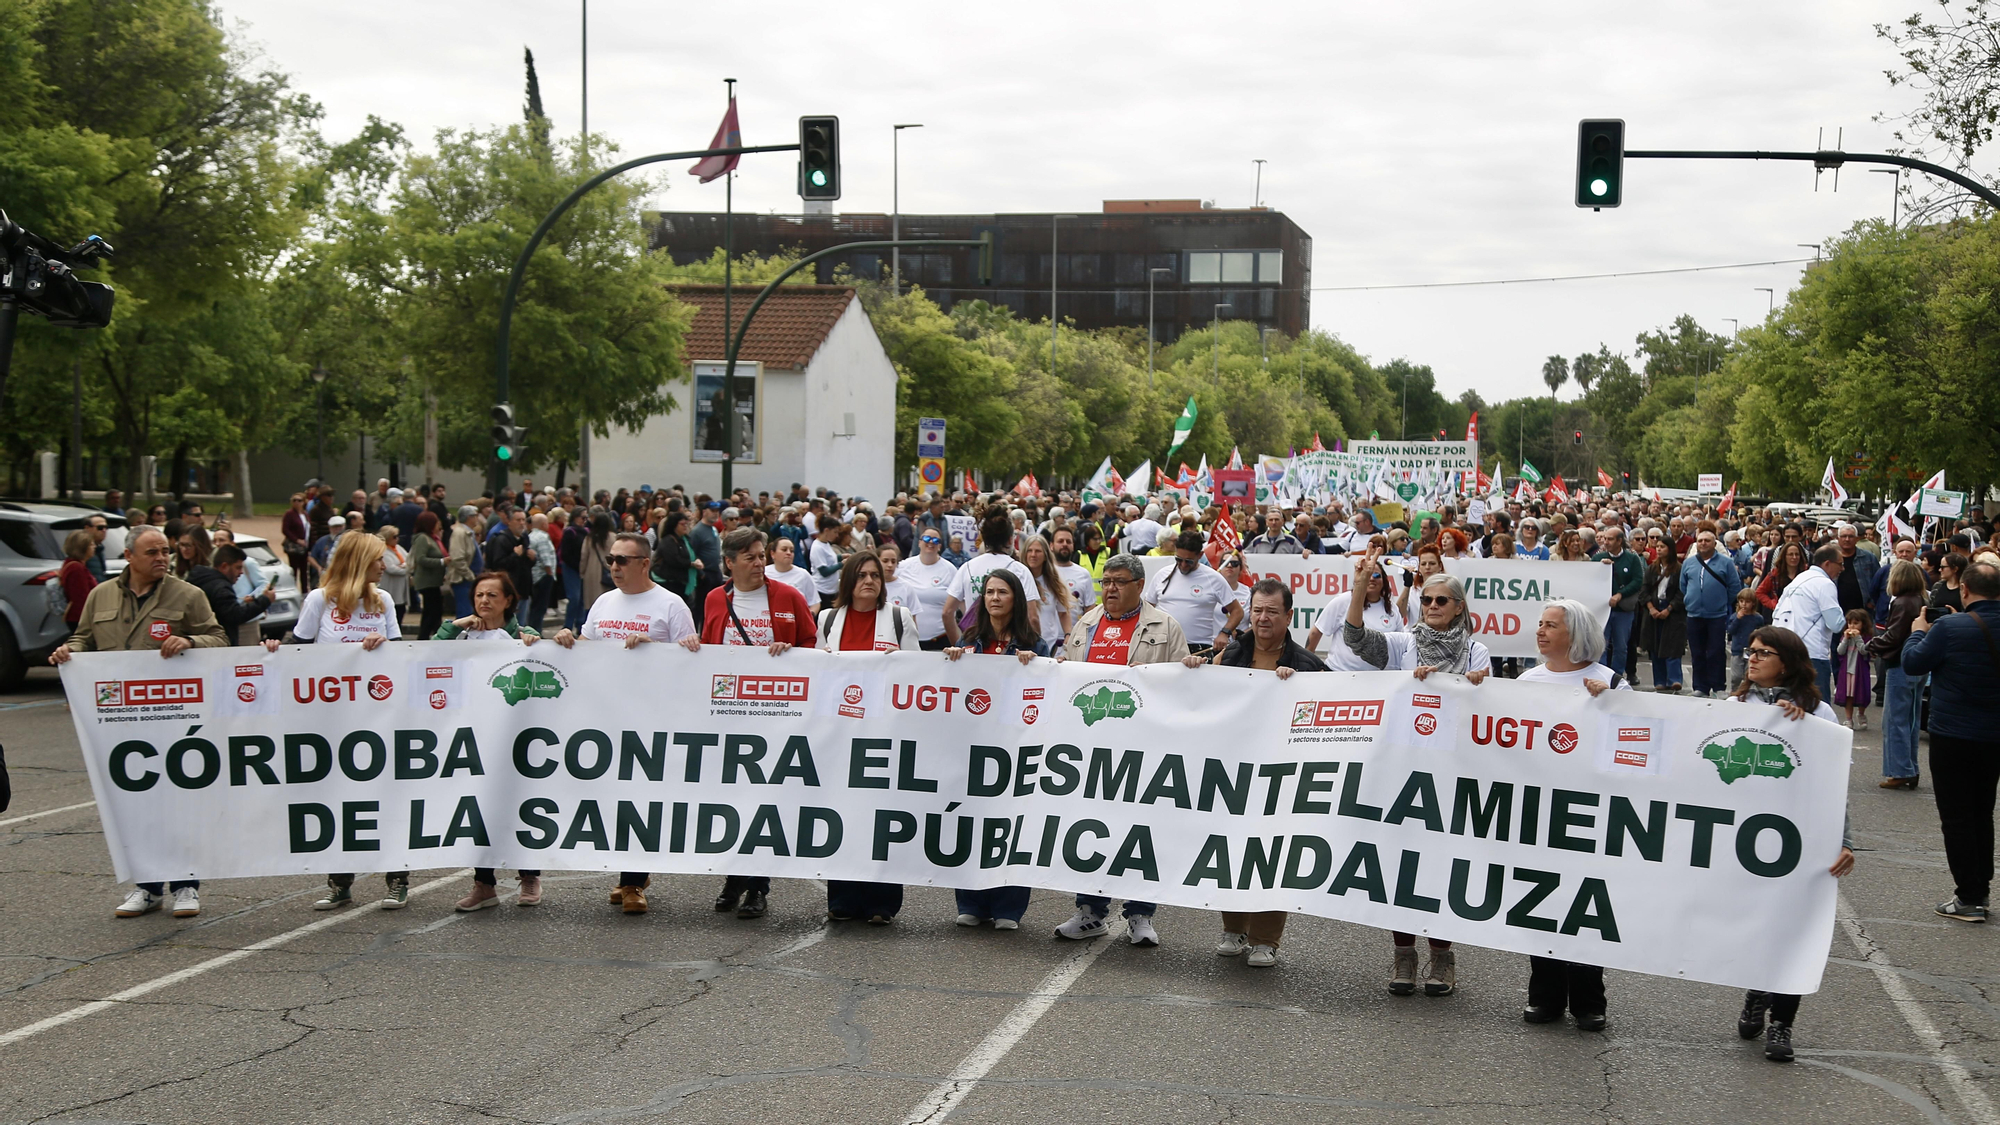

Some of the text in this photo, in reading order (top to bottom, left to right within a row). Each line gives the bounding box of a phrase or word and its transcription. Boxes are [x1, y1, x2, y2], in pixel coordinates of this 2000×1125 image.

[1357, 444, 1466, 455] FERNÁN NÚÑEZ POR
[151, 623, 171, 635] UGT
[129, 683, 198, 701] CCOO
[293, 675, 362, 704] UGT
[741, 680, 805, 697] CCOO
[845, 687, 861, 697] UGT
[711, 699, 747, 707] federación
[892, 683, 960, 713] UGT
[97, 705, 139, 713] federación
[152, 704, 184, 712] sanidad
[716, 708, 747, 716] sectores
[748, 709, 803, 717] sociosanitarios
[1319, 705, 1380, 722] CCOO
[140, 713, 200, 722] sociosanitarios
[1416, 714, 1435, 726] UGT
[1290, 726, 1324, 734] federación
[1471, 713, 1544, 751] UGT
[1292, 736, 1321, 744] sectores
[1321, 735, 1373, 743] sociosanitarios
[1764, 760, 1786, 768] CAMB
[109, 725, 1803, 878] CÓRDOBA CONTRA EL DESMANTELAMIENTO
[288, 796, 1622, 943] DE LA SANIDAD PÚBLICA ANDALUZA
